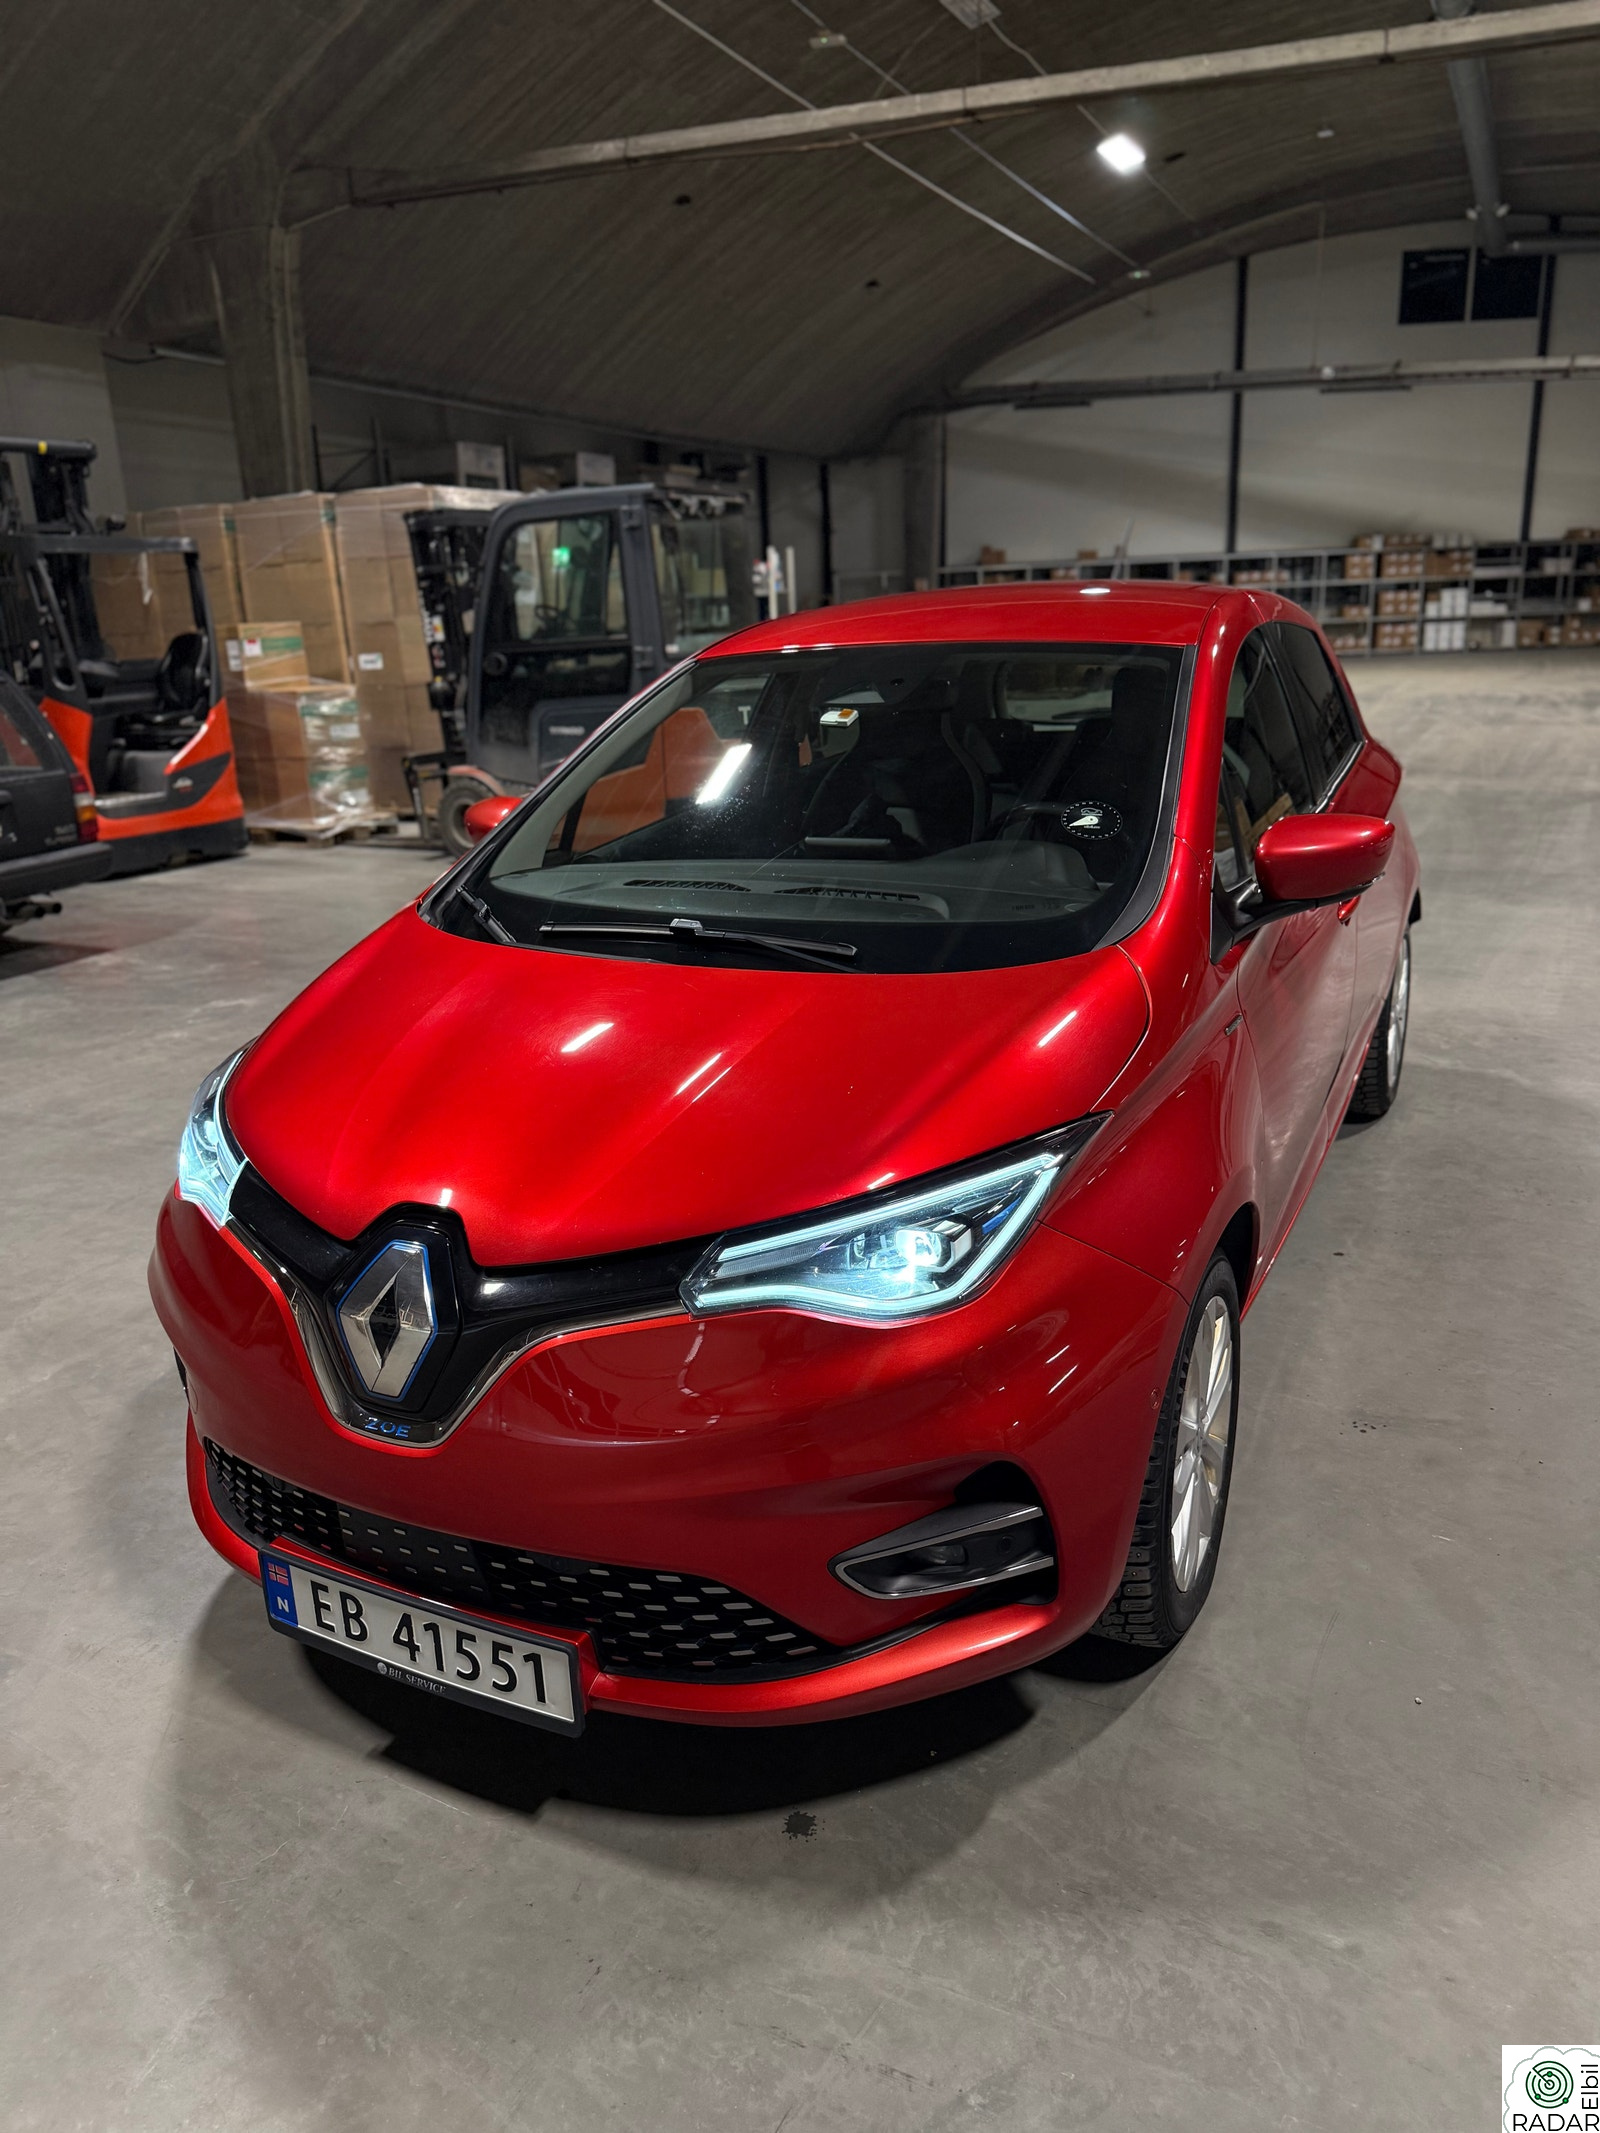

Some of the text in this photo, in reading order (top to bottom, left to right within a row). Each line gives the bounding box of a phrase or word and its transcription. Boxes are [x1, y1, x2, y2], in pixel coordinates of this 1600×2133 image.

[365, 1416, 411, 1438] ZOE
[277, 1596, 289, 1613] N
[310, 1580, 547, 1704] EB 41551
[405, 1673, 447, 1694] SERVICE
